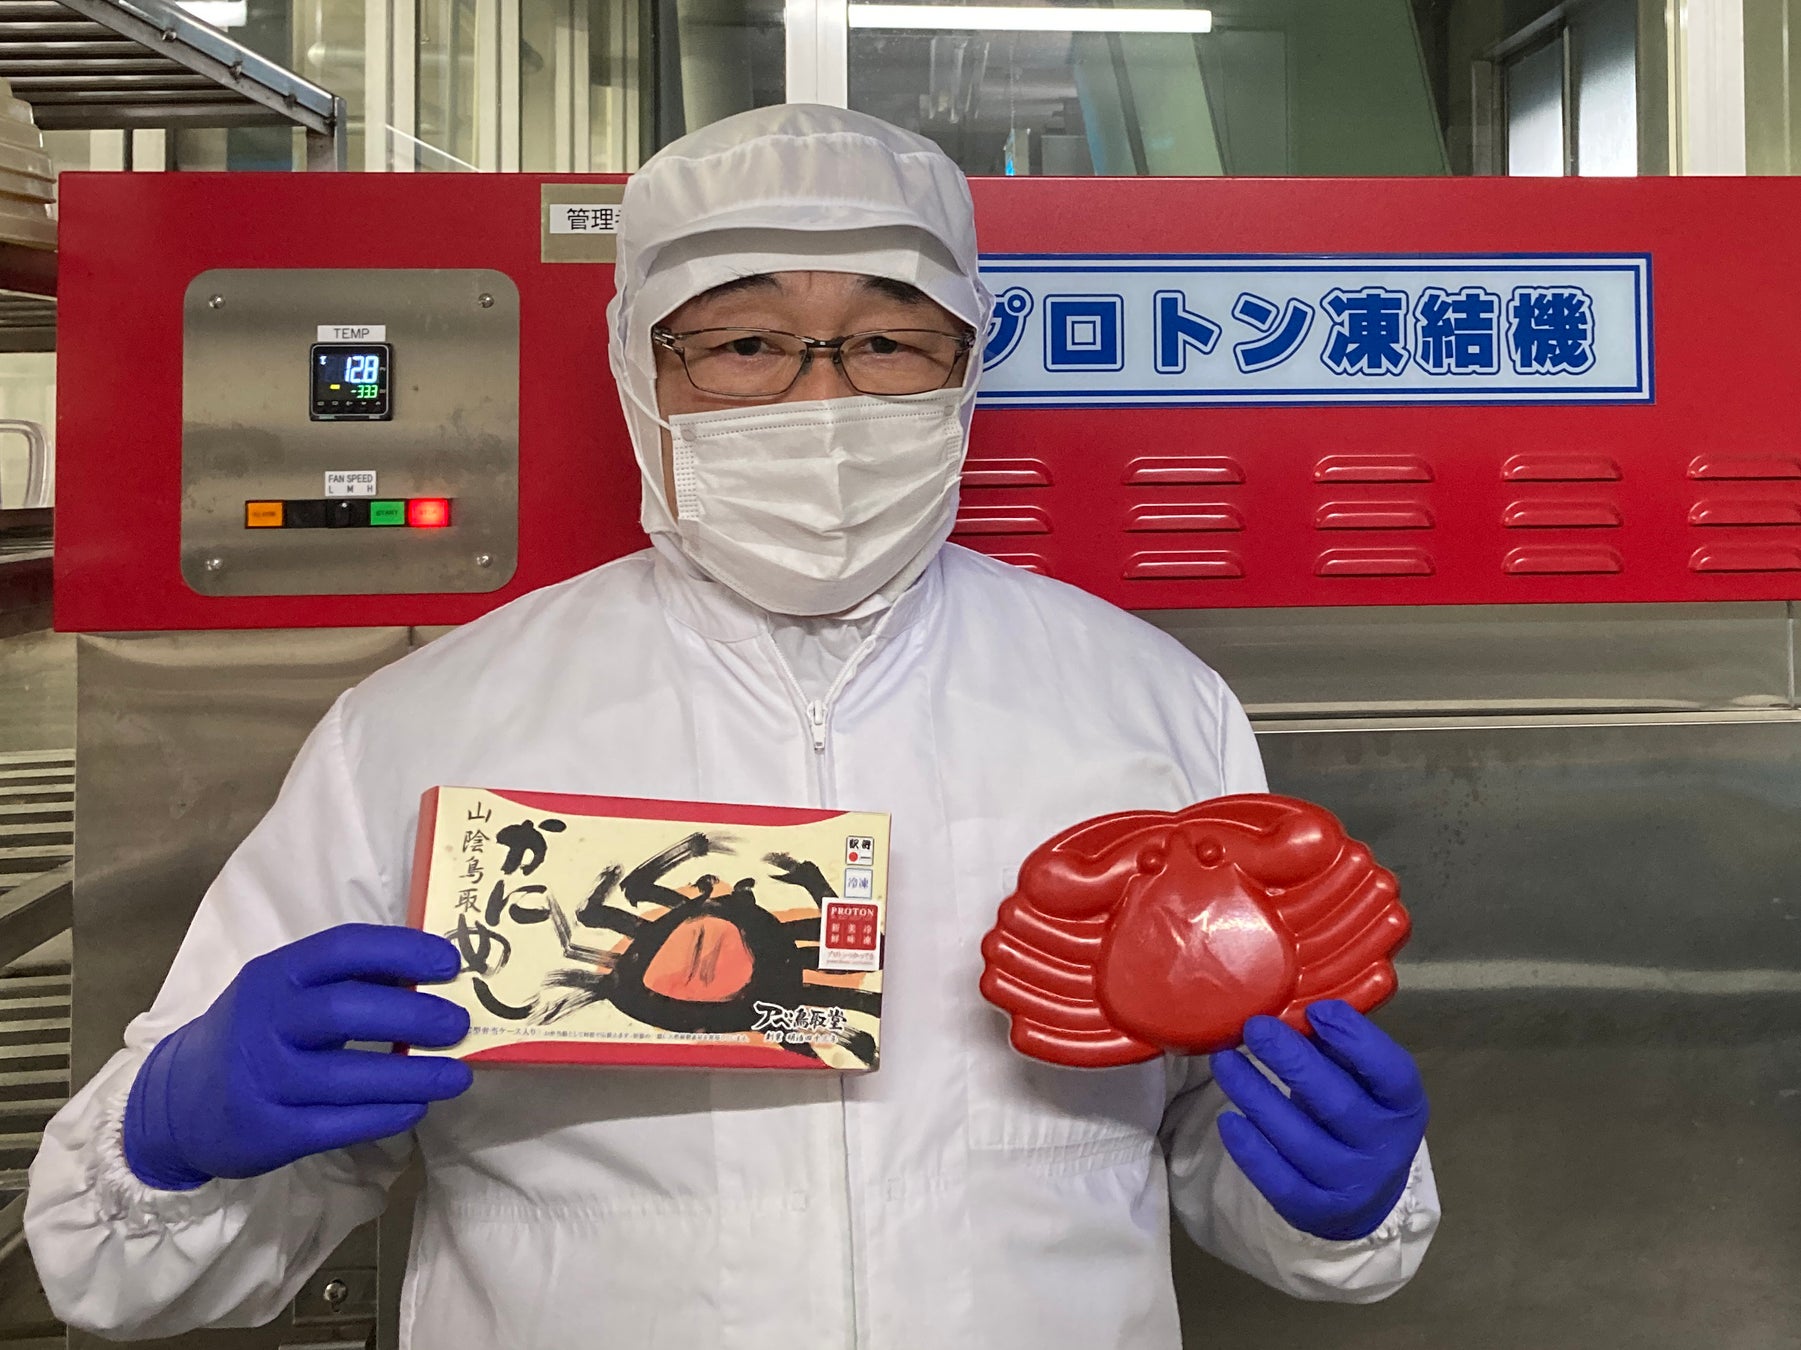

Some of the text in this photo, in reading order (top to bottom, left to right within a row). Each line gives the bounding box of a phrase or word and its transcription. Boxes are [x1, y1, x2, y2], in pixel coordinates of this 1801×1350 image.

[566, 208, 621, 231] 管理
[333, 327, 370, 339] TEMP
[328, 474, 373, 484] FAN SPEED
[328, 484, 374, 494] L M H
[454, 800, 492, 914] 山陰鳥取
[830, 906, 874, 917] PROTON
